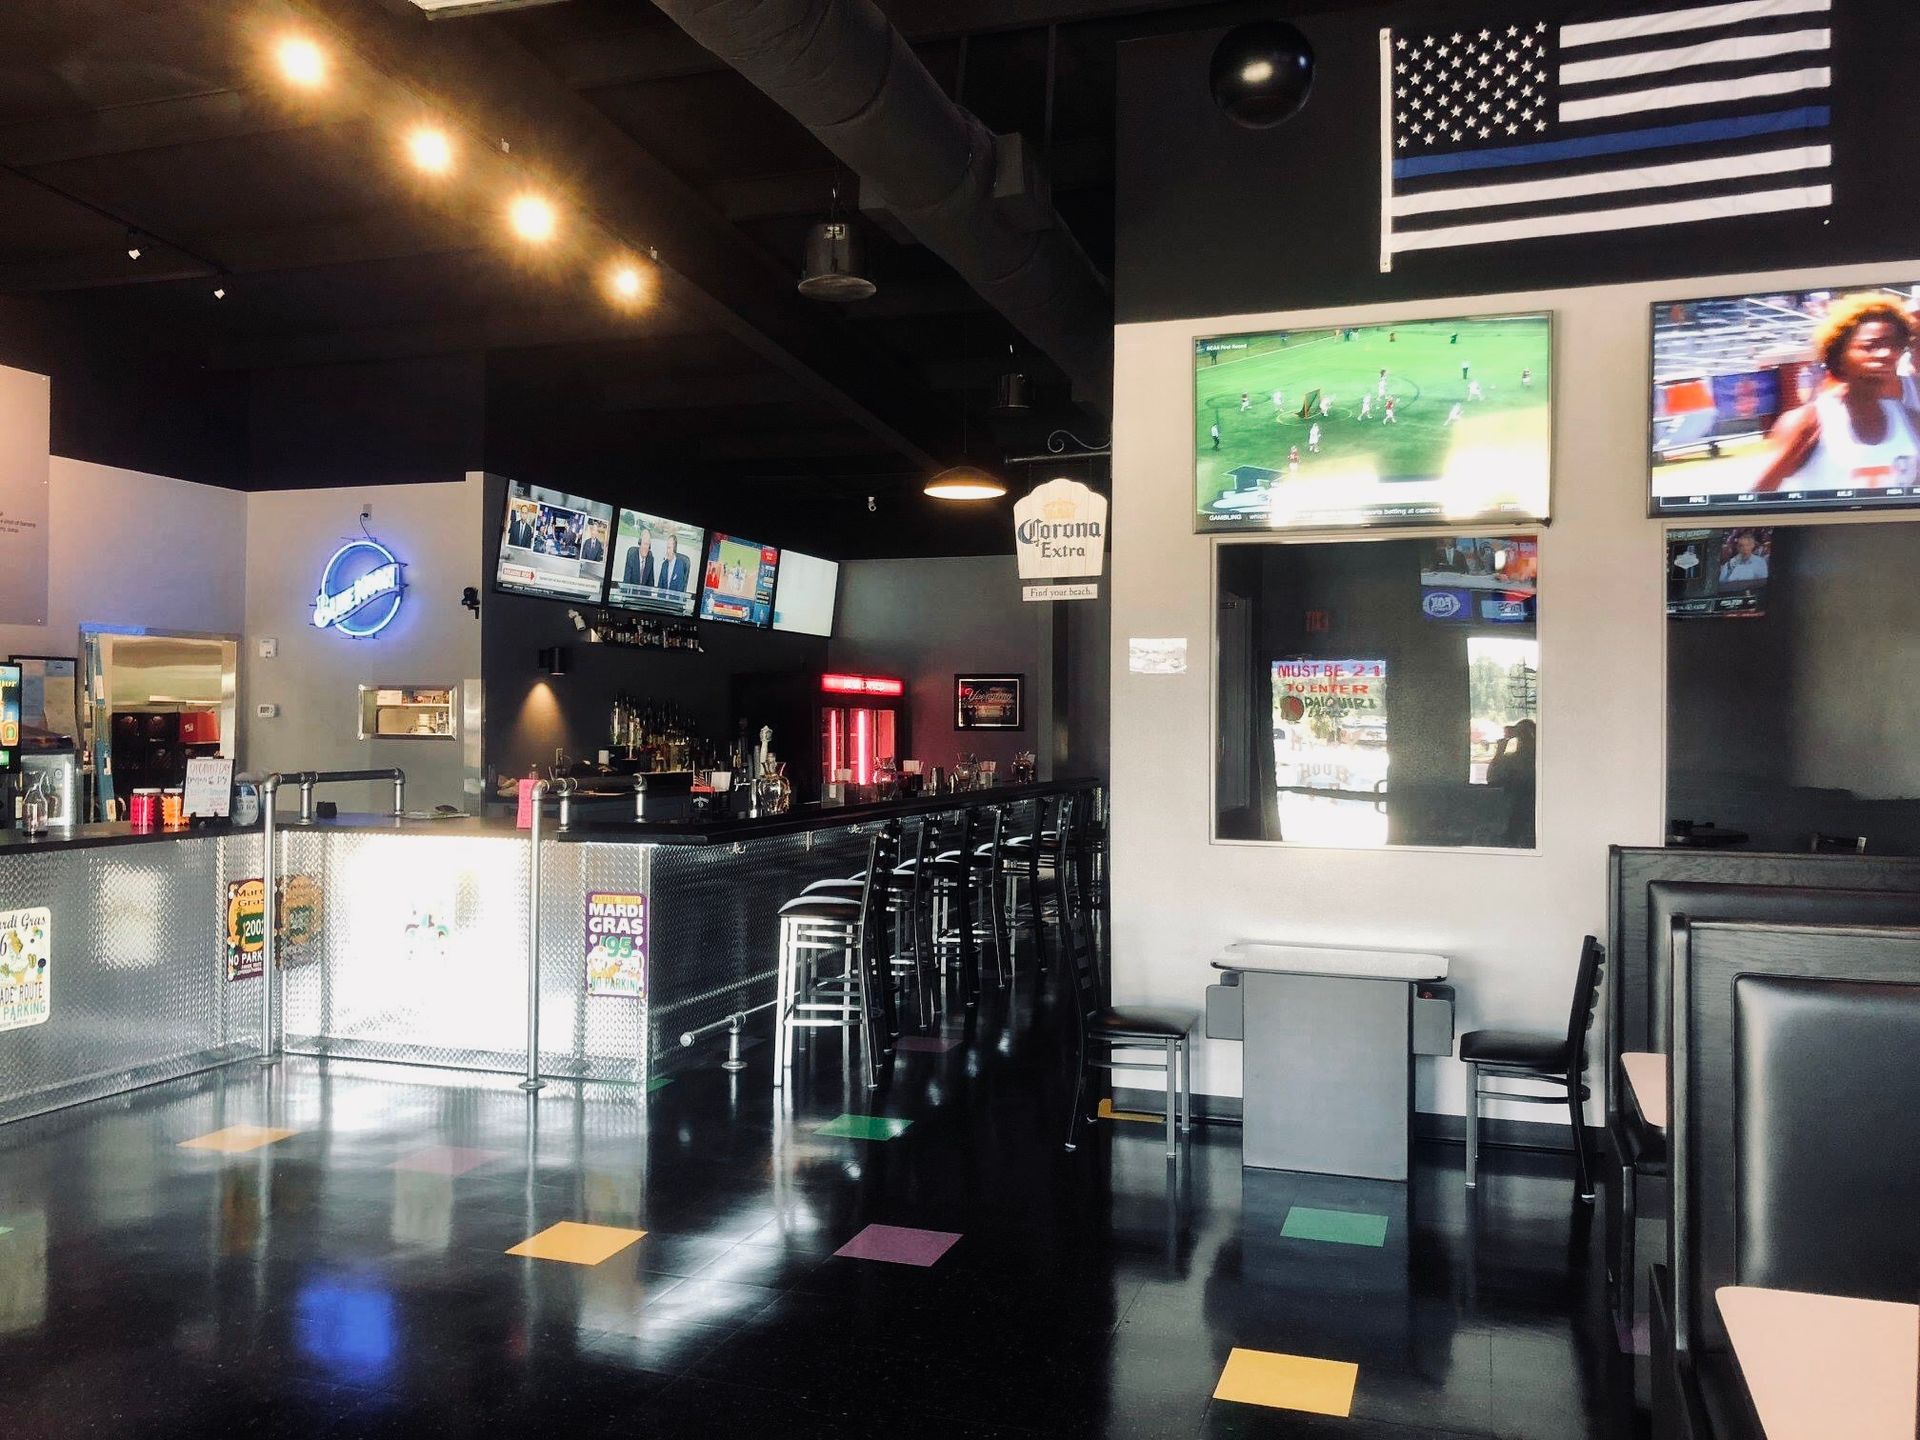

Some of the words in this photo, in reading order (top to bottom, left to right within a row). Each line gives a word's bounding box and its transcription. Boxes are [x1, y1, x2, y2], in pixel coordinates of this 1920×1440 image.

[1209, 513, 1242, 521] GAMBLING
[1384, 508, 1406, 516] betting
[1017, 518, 1102, 547] Corona
[1041, 541, 1085, 559] Extra
[1030, 587, 1048, 597] Find
[1050, 589, 1067, 599] your
[1278, 664, 1319, 678] MUST
[1324, 664, 1344, 677] BE
[1286, 683, 1305, 694] TO
[1310, 684, 1369, 694] ENTER
[589, 903, 644, 917] MARDI
[22, 913, 46, 930] Gras
[589, 917, 644, 935] GRAS
[600, 935, 632, 958] '95
[228, 954, 240, 966] NO
[242, 950, 264, 964] PARK
[20, 981, 43, 1001] ROUTE
[3, 1001, 46, 1021] PARKING
